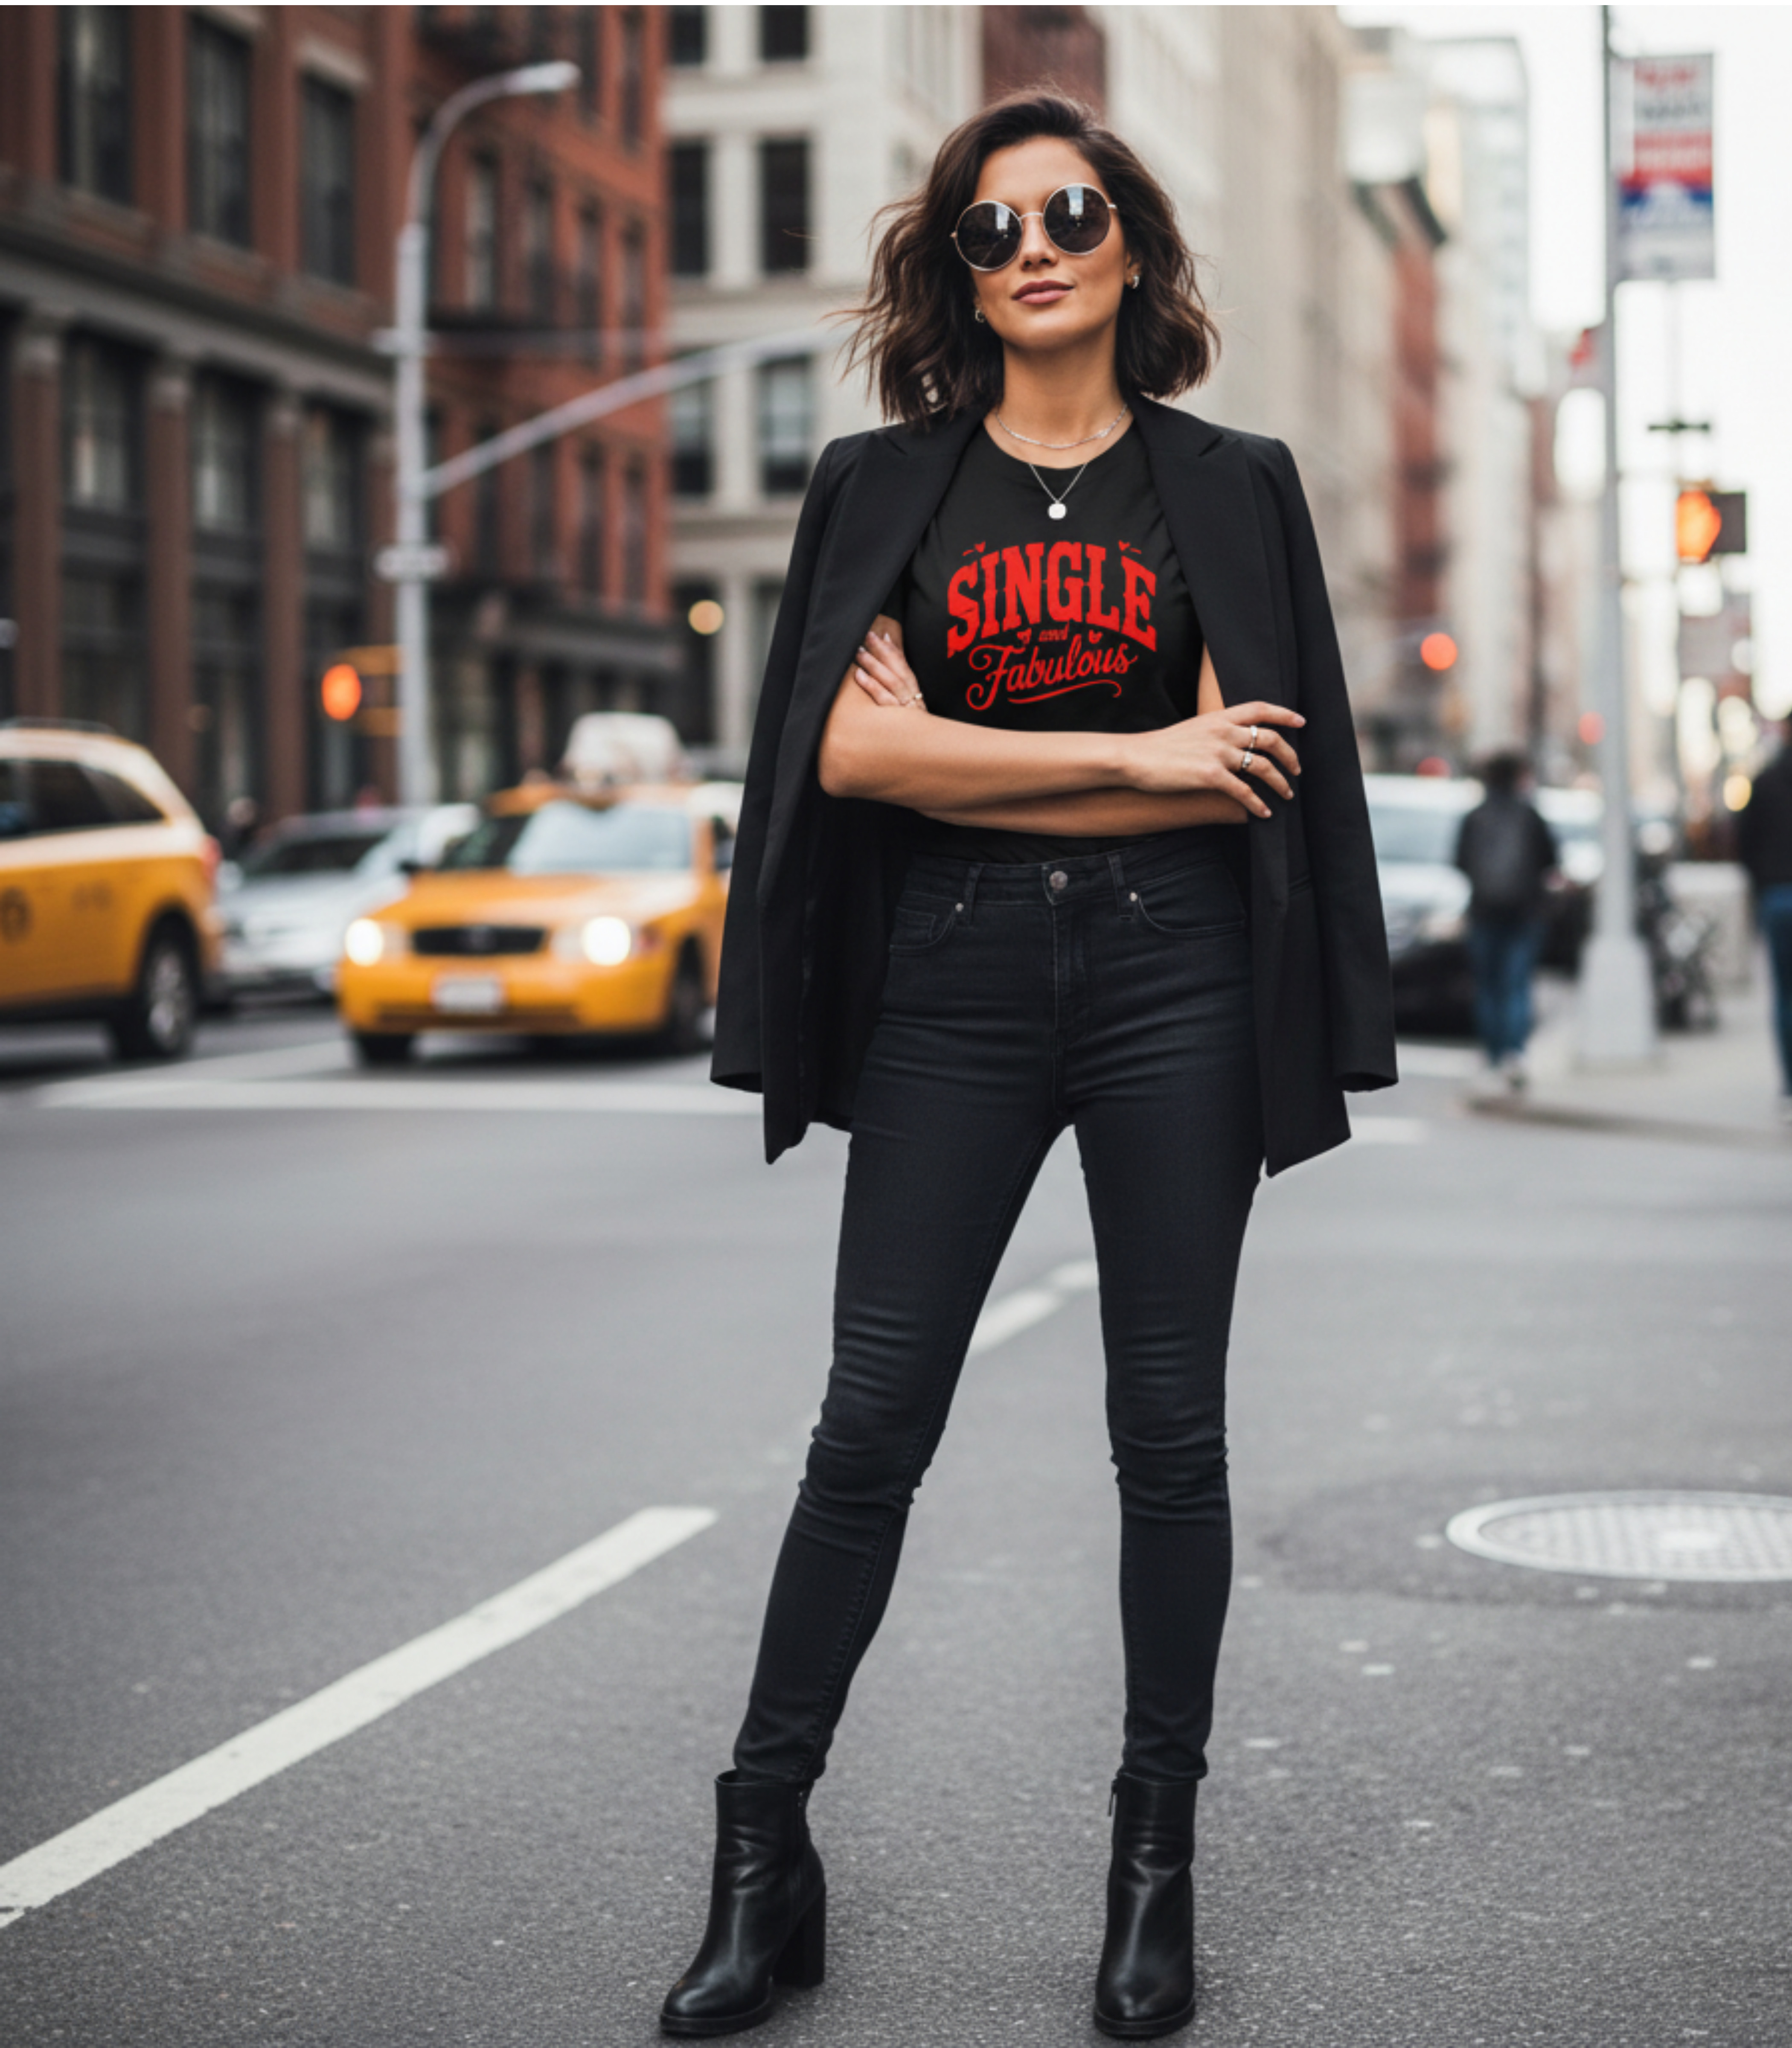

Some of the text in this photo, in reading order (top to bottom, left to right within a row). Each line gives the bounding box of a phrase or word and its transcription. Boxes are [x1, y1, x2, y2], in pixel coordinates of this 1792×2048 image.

[947, 541, 1157, 658] SINGLE
[1039, 622, 1069, 642] and
[966, 634, 1138, 711] Fabulous
